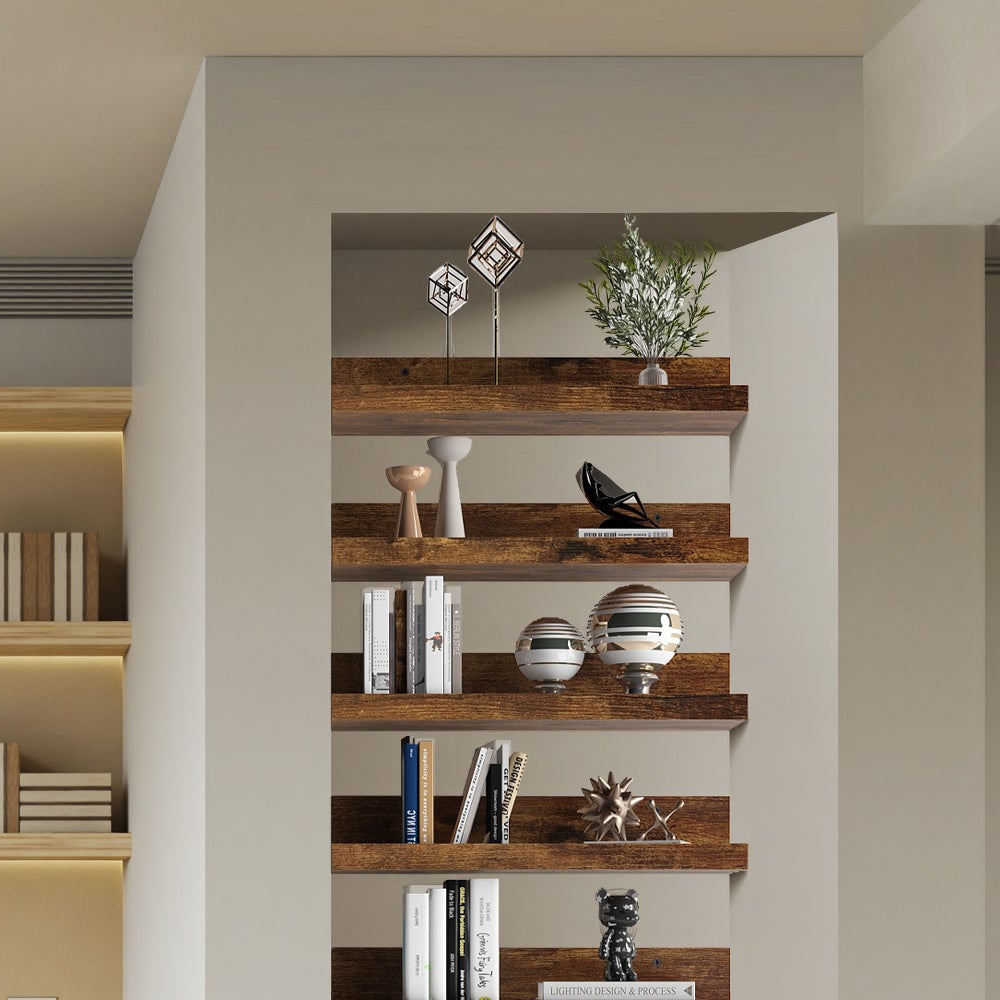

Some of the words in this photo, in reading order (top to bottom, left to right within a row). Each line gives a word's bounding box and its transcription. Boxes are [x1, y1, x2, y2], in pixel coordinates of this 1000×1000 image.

[472, 754, 485, 784] simplicity
[509, 756, 523, 784] DESIGN
[457, 800, 470, 833] everything
[458, 939, 466, 957] Gospel
[474, 956, 491, 972] Fairy
[477, 970, 493, 989] Tales
[550, 986, 593, 996] LIGHTING
[594, 986, 627, 996] DESIGN
[628, 986, 636, 996] &
[638, 986, 677, 996] PROCESS
